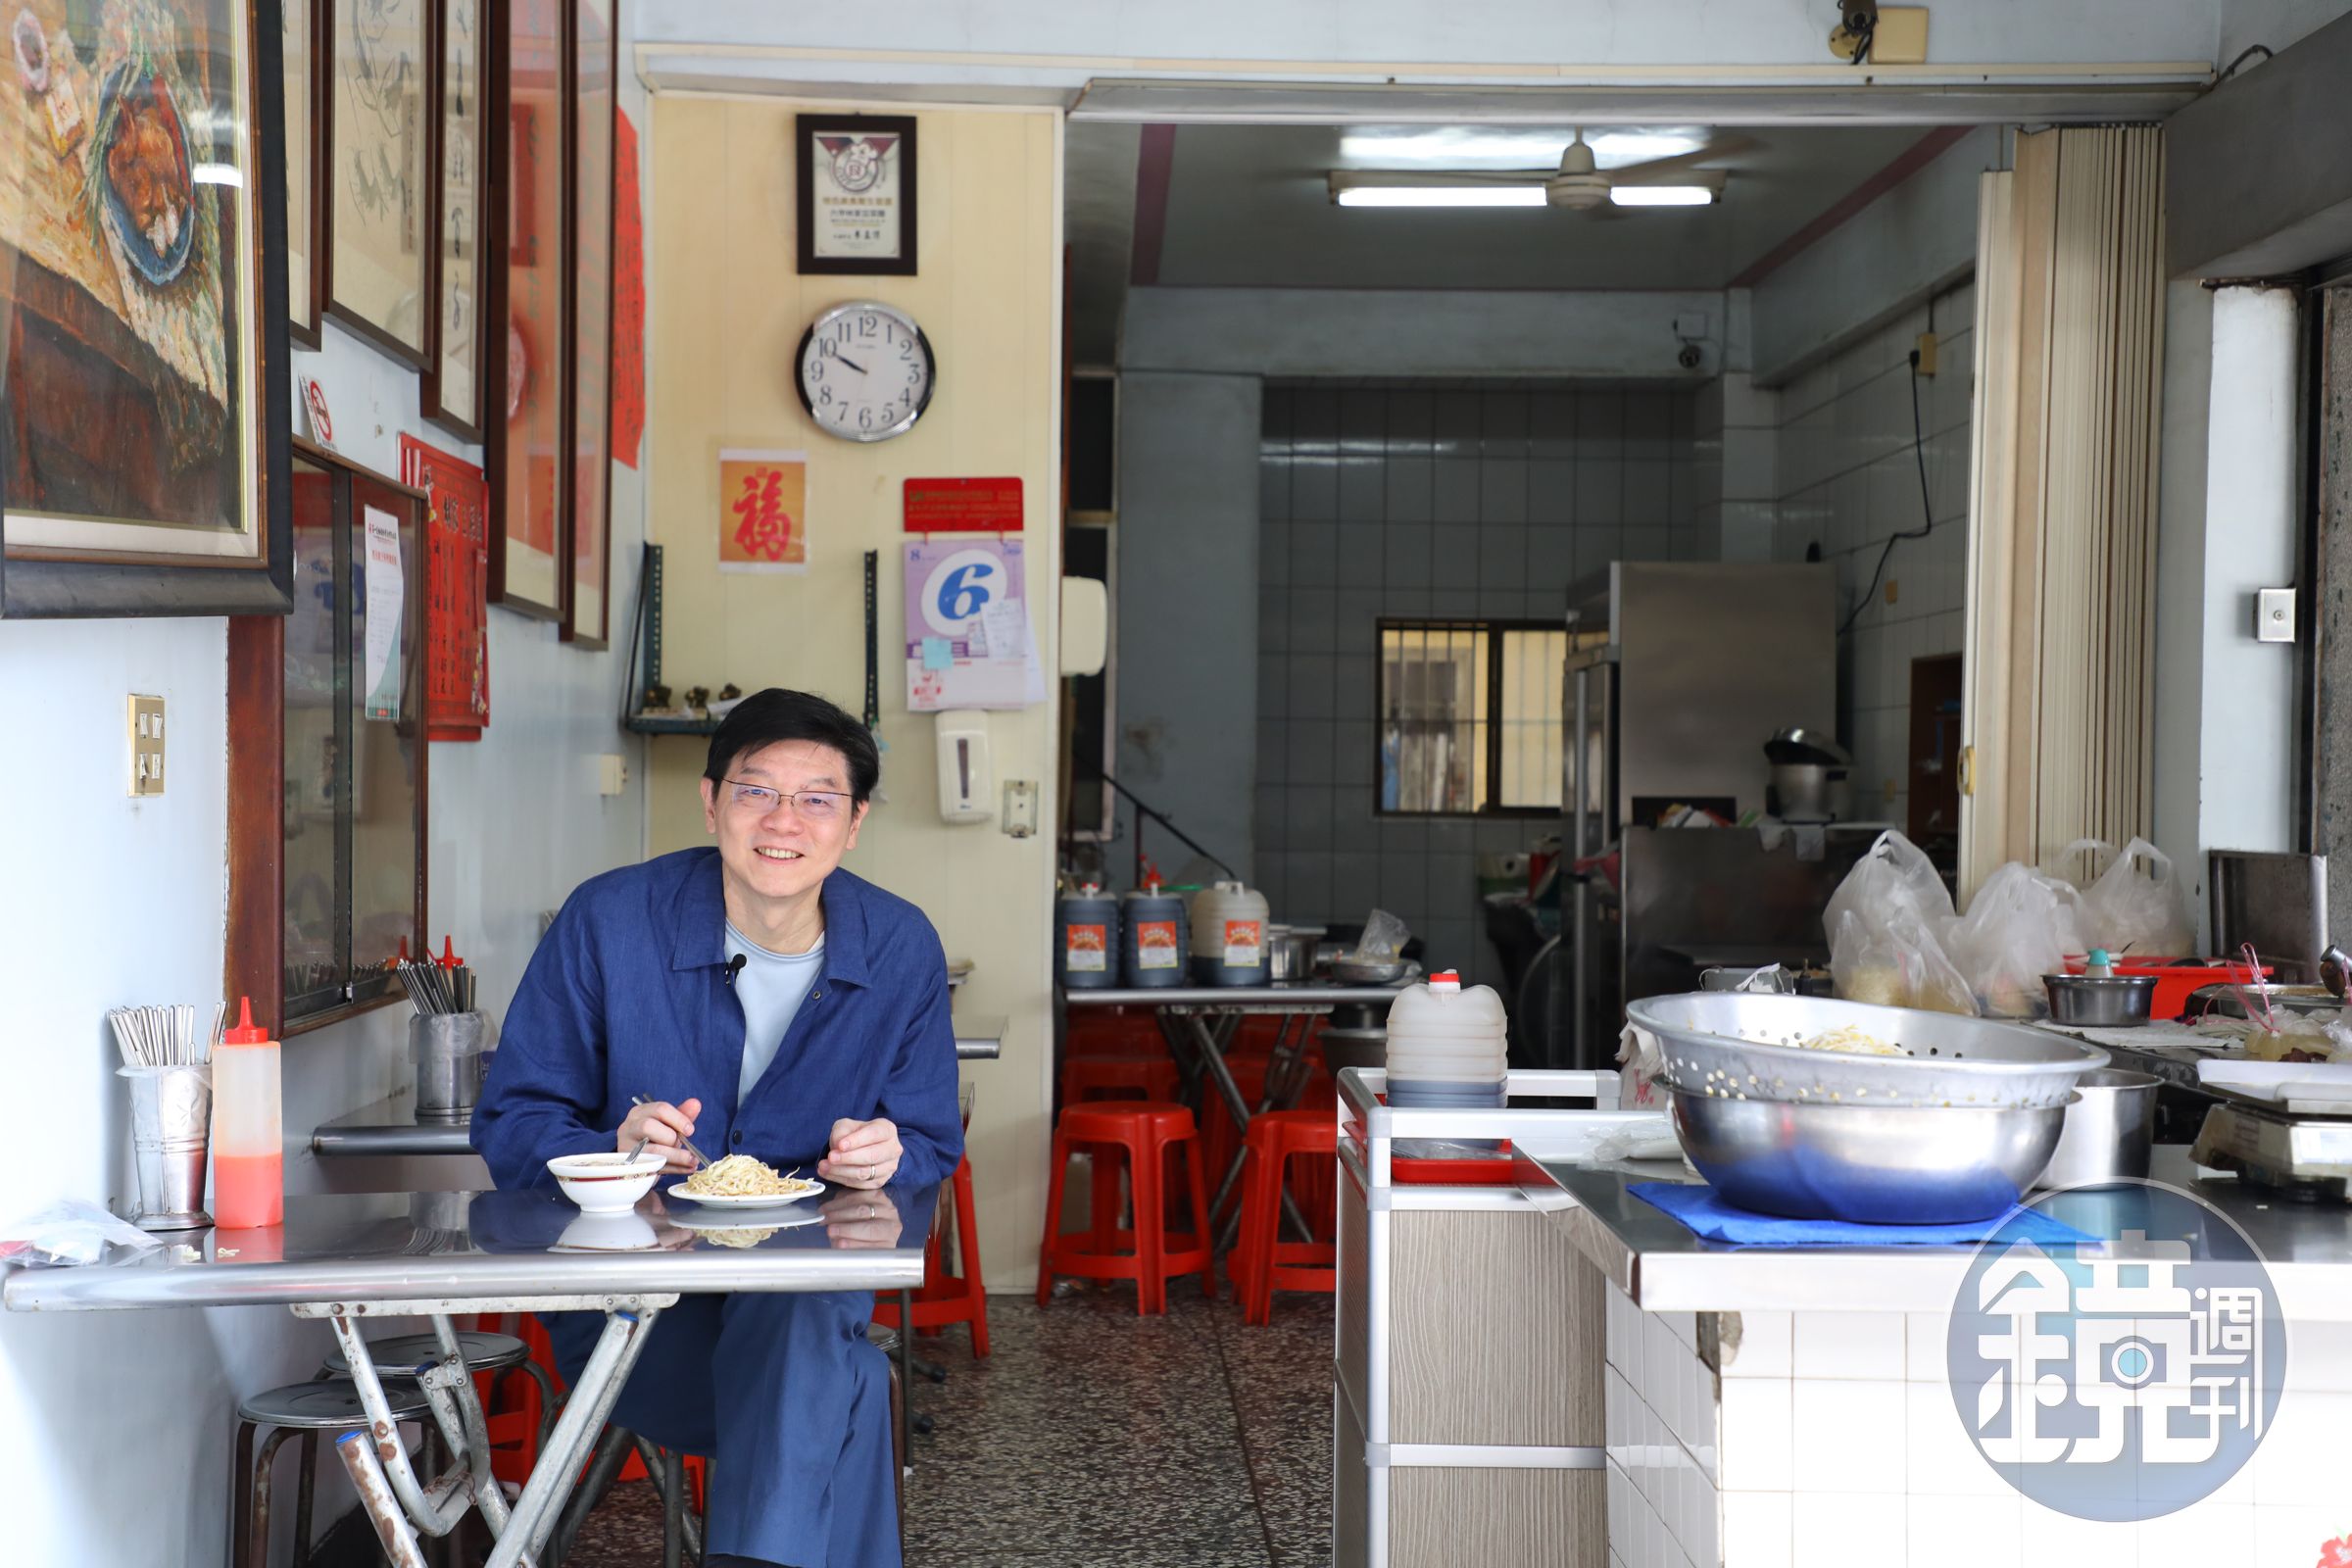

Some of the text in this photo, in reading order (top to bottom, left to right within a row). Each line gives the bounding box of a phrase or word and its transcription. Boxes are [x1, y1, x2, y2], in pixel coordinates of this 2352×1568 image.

[838, 322, 851, 343] 11
[858, 316, 877, 337] 12
[886, 323, 893, 344] 1
[818, 337, 837, 359] 10
[900, 339, 912, 361] 2
[810, 360, 824, 382] 9
[907, 364, 920, 384] 3
[819, 384, 832, 406] 8
[899, 387, 911, 408] 4
[838, 401, 849, 421] 7
[858, 407, 871, 429] 6
[881, 403, 894, 423] 5
[732, 470, 792, 563] 福
[937, 564, 994, 620] 6
